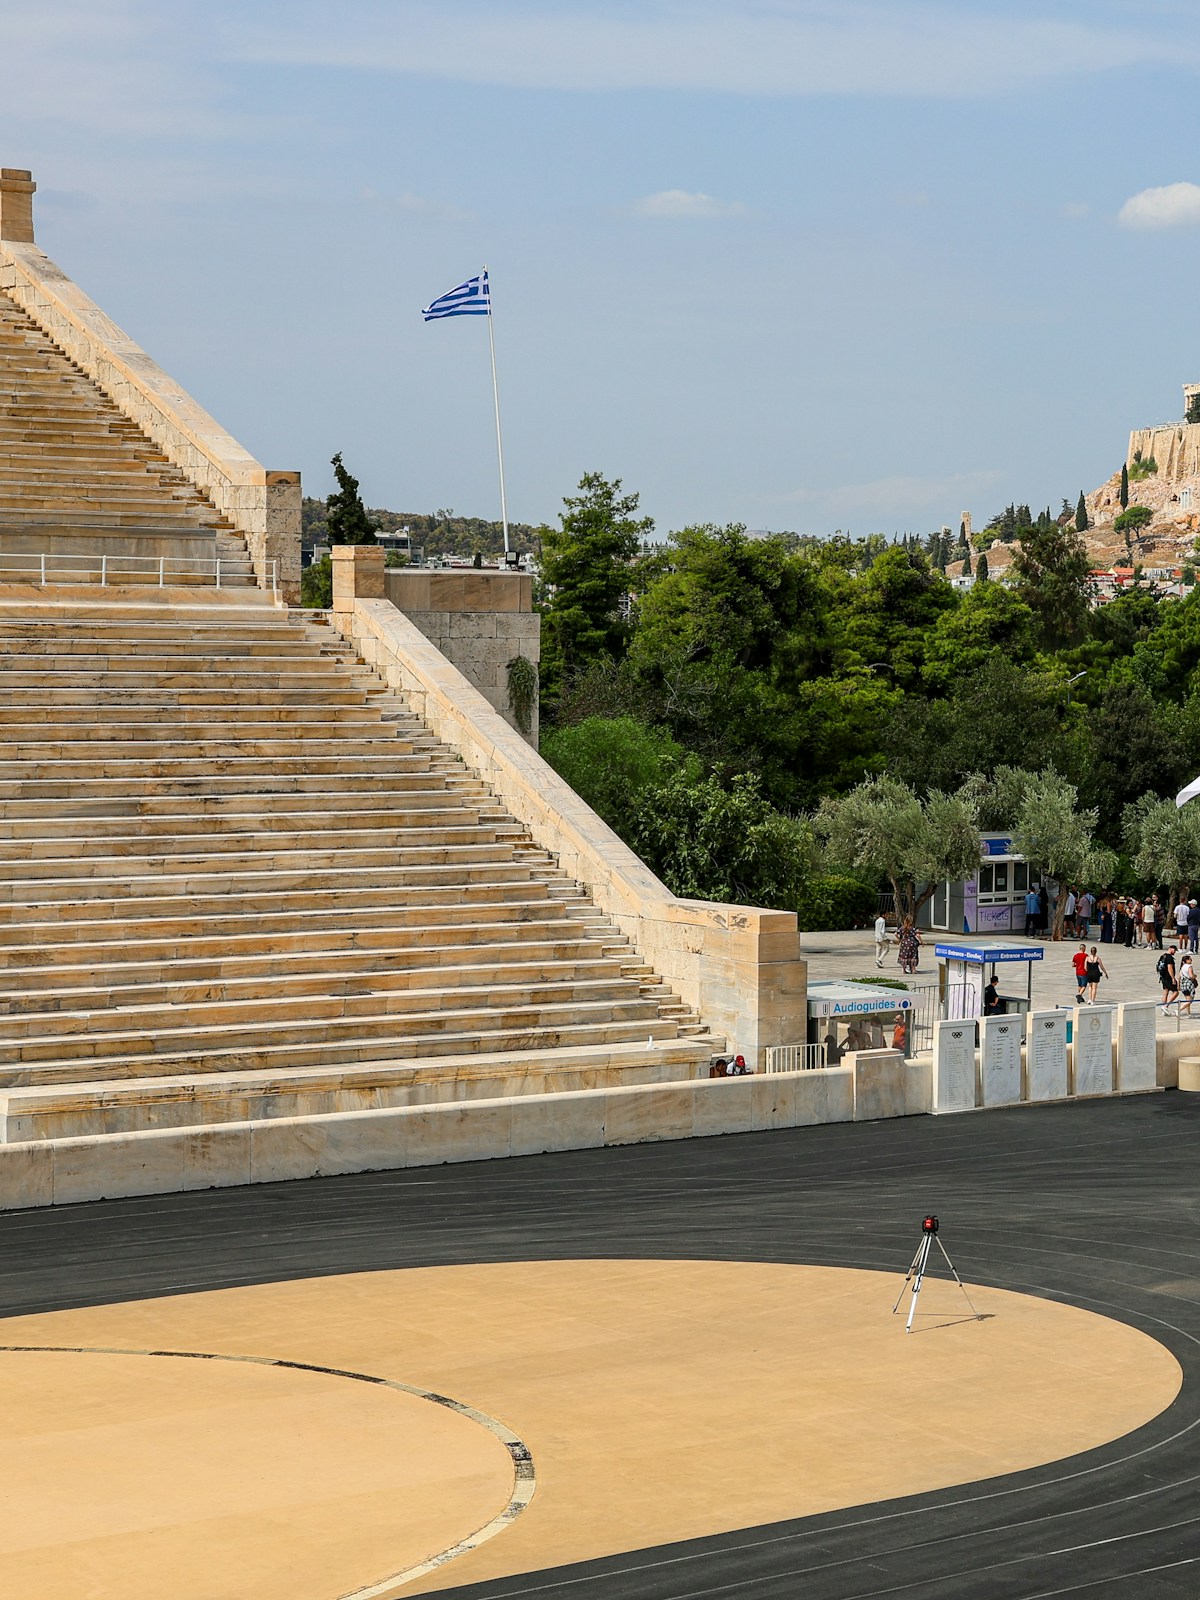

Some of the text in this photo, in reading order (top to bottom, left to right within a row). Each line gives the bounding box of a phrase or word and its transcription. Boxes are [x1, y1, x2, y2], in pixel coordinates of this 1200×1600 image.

[979, 910, 1009, 922] Tickets
[947, 950, 964, 958] Entrance
[833, 1000, 896, 1014] Audioguides
